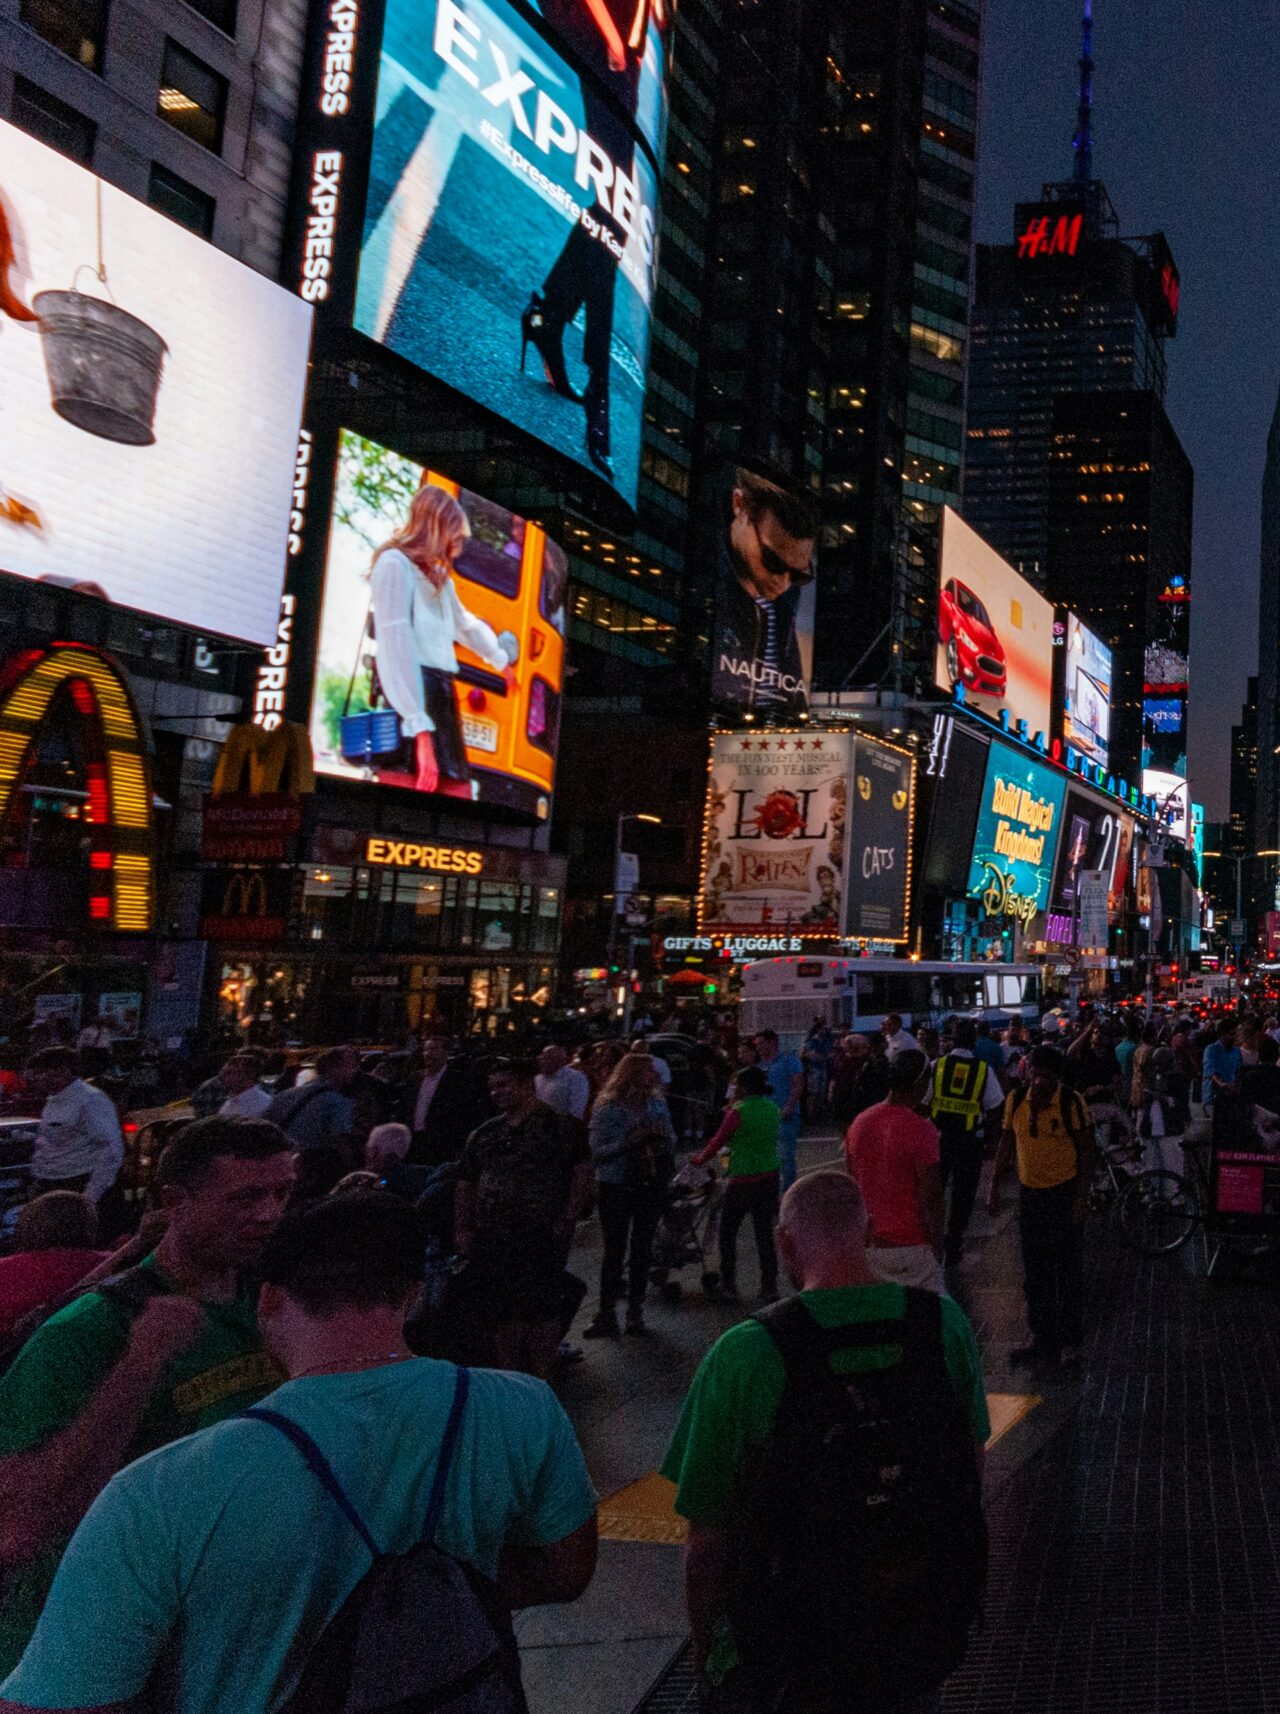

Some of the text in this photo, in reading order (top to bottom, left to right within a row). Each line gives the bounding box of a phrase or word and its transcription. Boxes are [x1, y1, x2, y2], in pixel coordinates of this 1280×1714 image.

[301, 150, 342, 302] EXPRESS
[1018, 214, 1083, 258] H&M
[1051, 635, 1064, 646] LG
[719, 654, 807, 693] NAUTICA
[797, 752, 843, 763] MUSICAL
[366, 838, 483, 874] EXPRESS
[862, 846, 896, 879] CATS
[1098, 814, 1123, 892] 21
[664, 937, 712, 950] GIFTS
